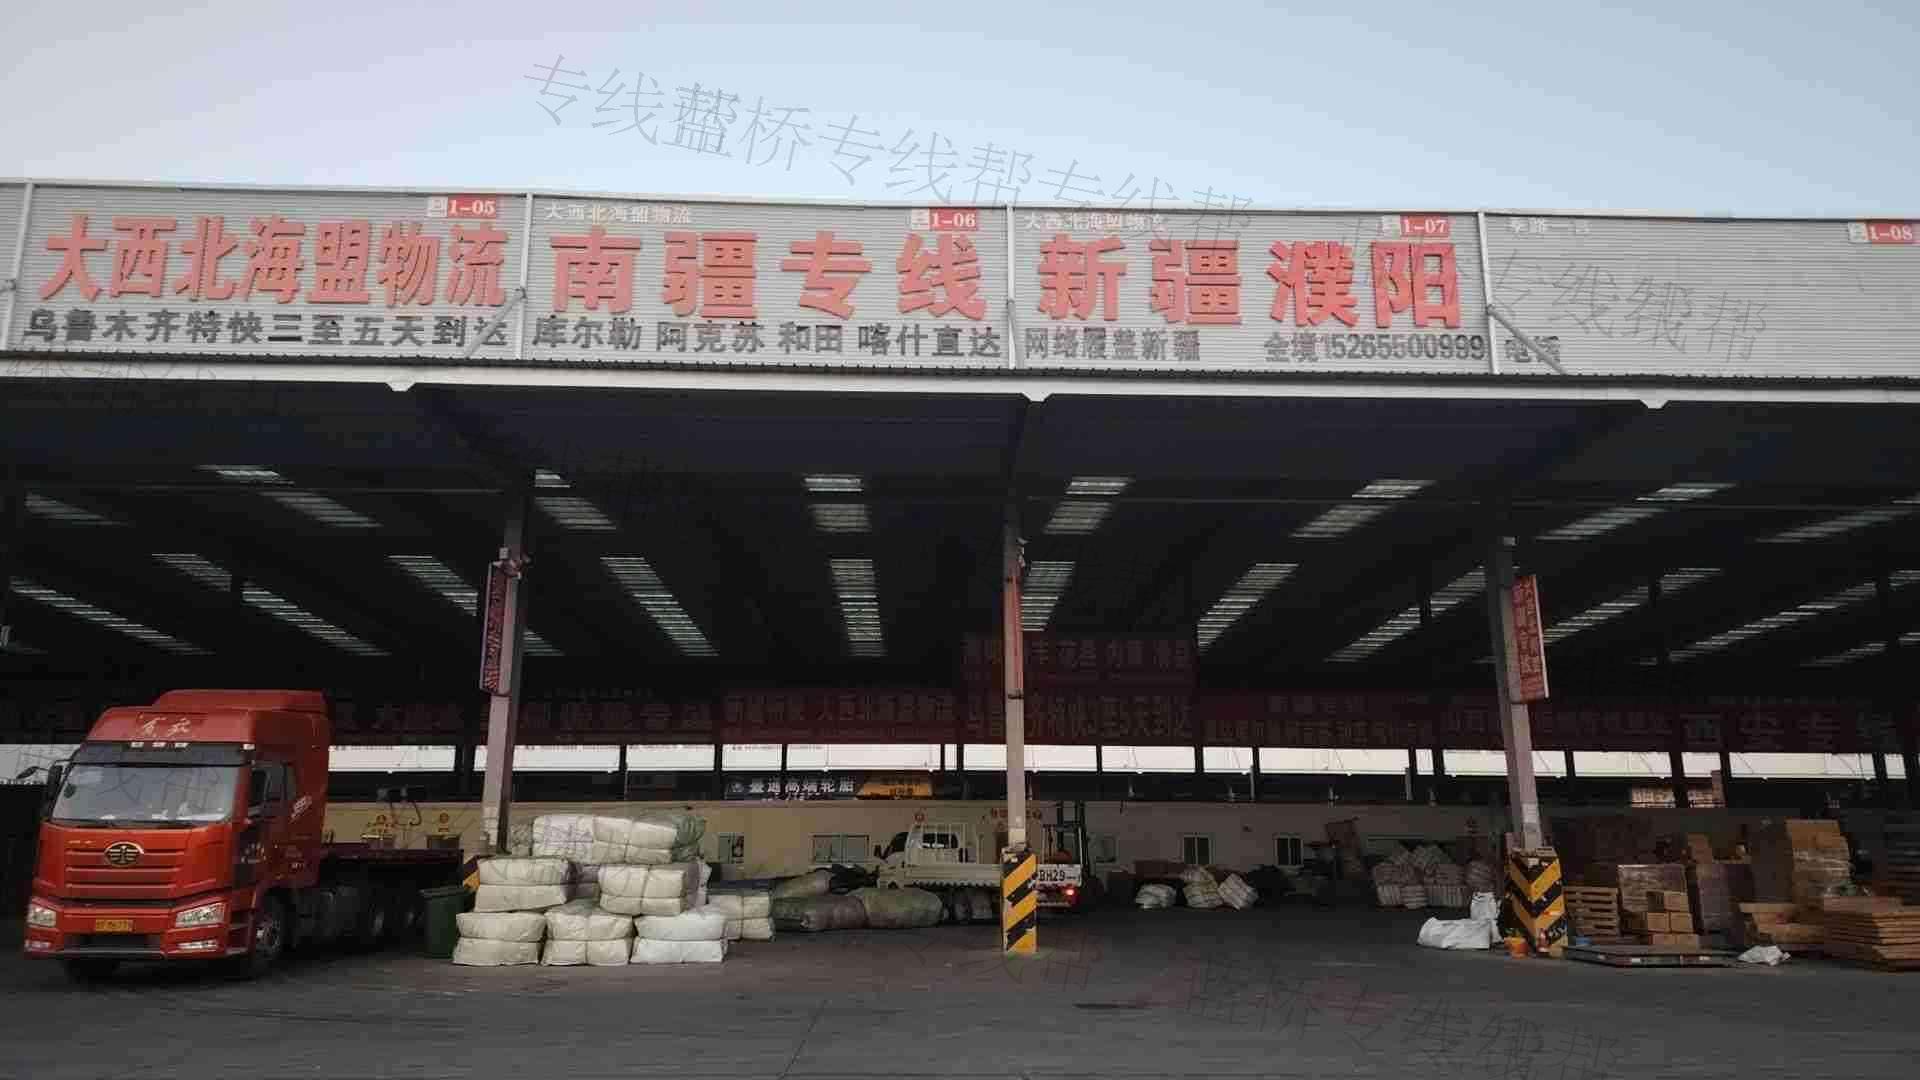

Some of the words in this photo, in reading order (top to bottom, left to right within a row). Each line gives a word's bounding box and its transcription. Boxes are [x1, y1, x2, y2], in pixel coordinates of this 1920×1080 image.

[40, 213, 509, 307] 大西北海盟物流
[549, 228, 987, 321] 南疆专线
[23, 308, 509, 348] 乌鲁木齐特快三至五天到达
[778, 322, 844, 355] 和田
